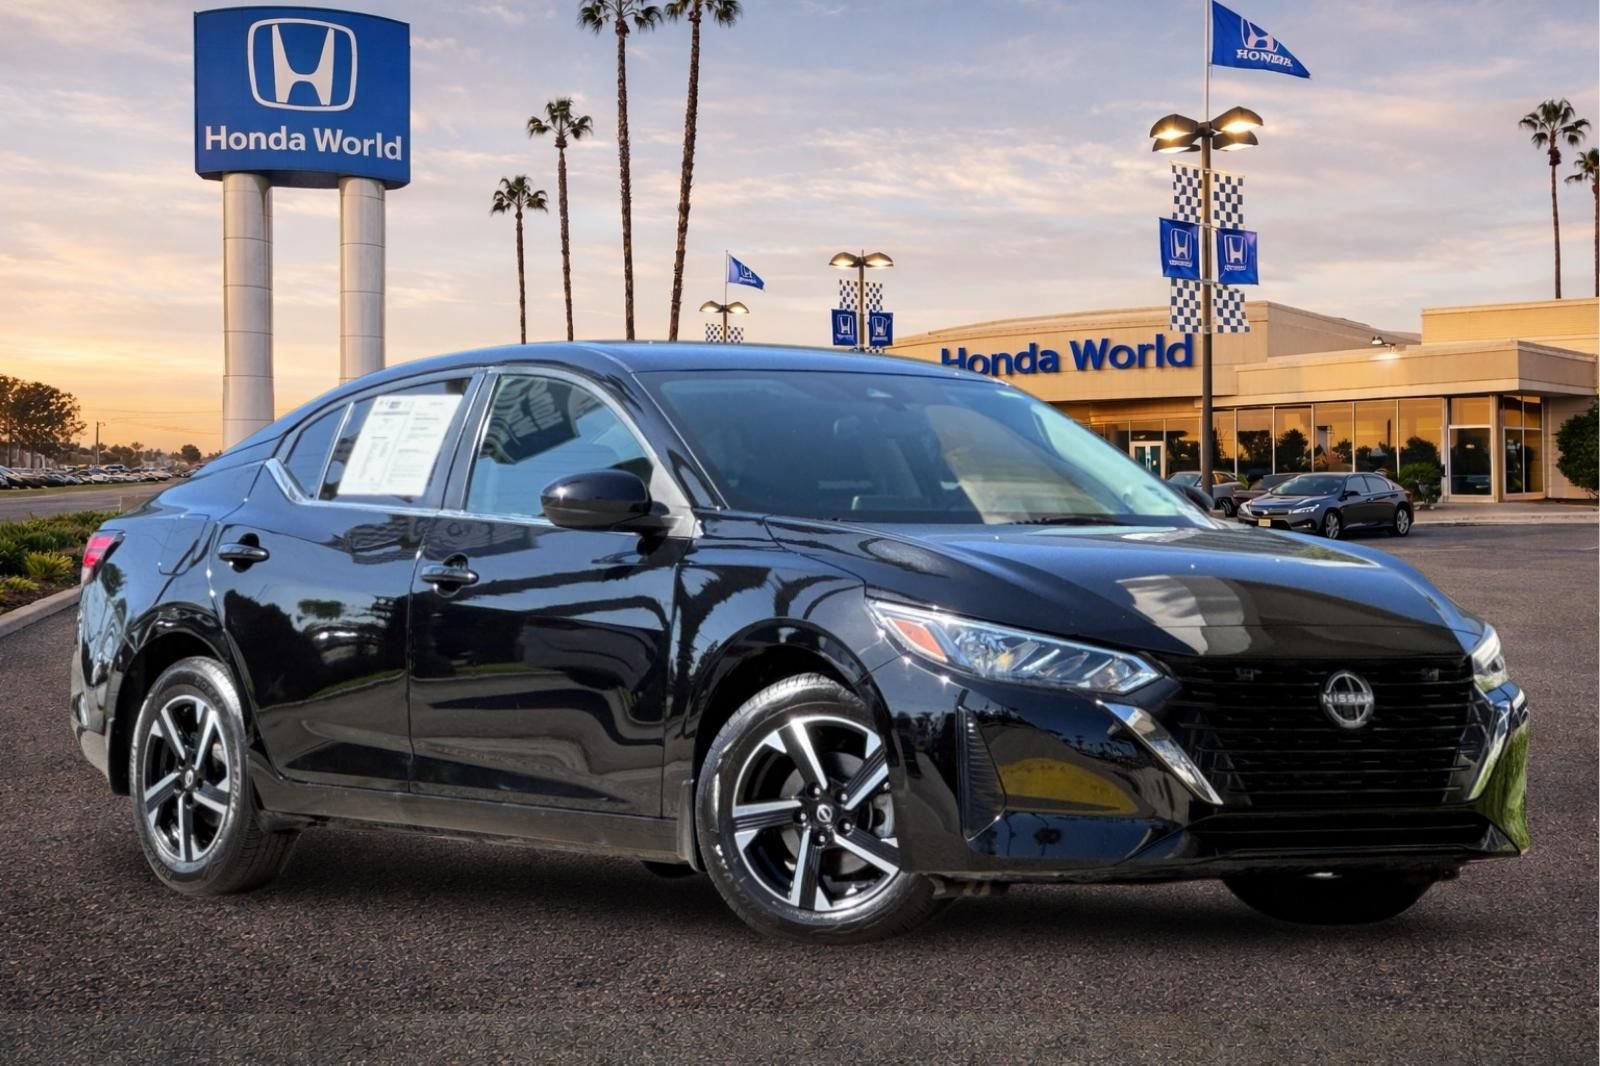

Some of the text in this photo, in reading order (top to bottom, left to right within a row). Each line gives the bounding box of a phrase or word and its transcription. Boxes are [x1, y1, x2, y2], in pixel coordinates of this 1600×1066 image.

[205, 126, 402, 161] Honda World
[941, 333, 1194, 377] Honda World
